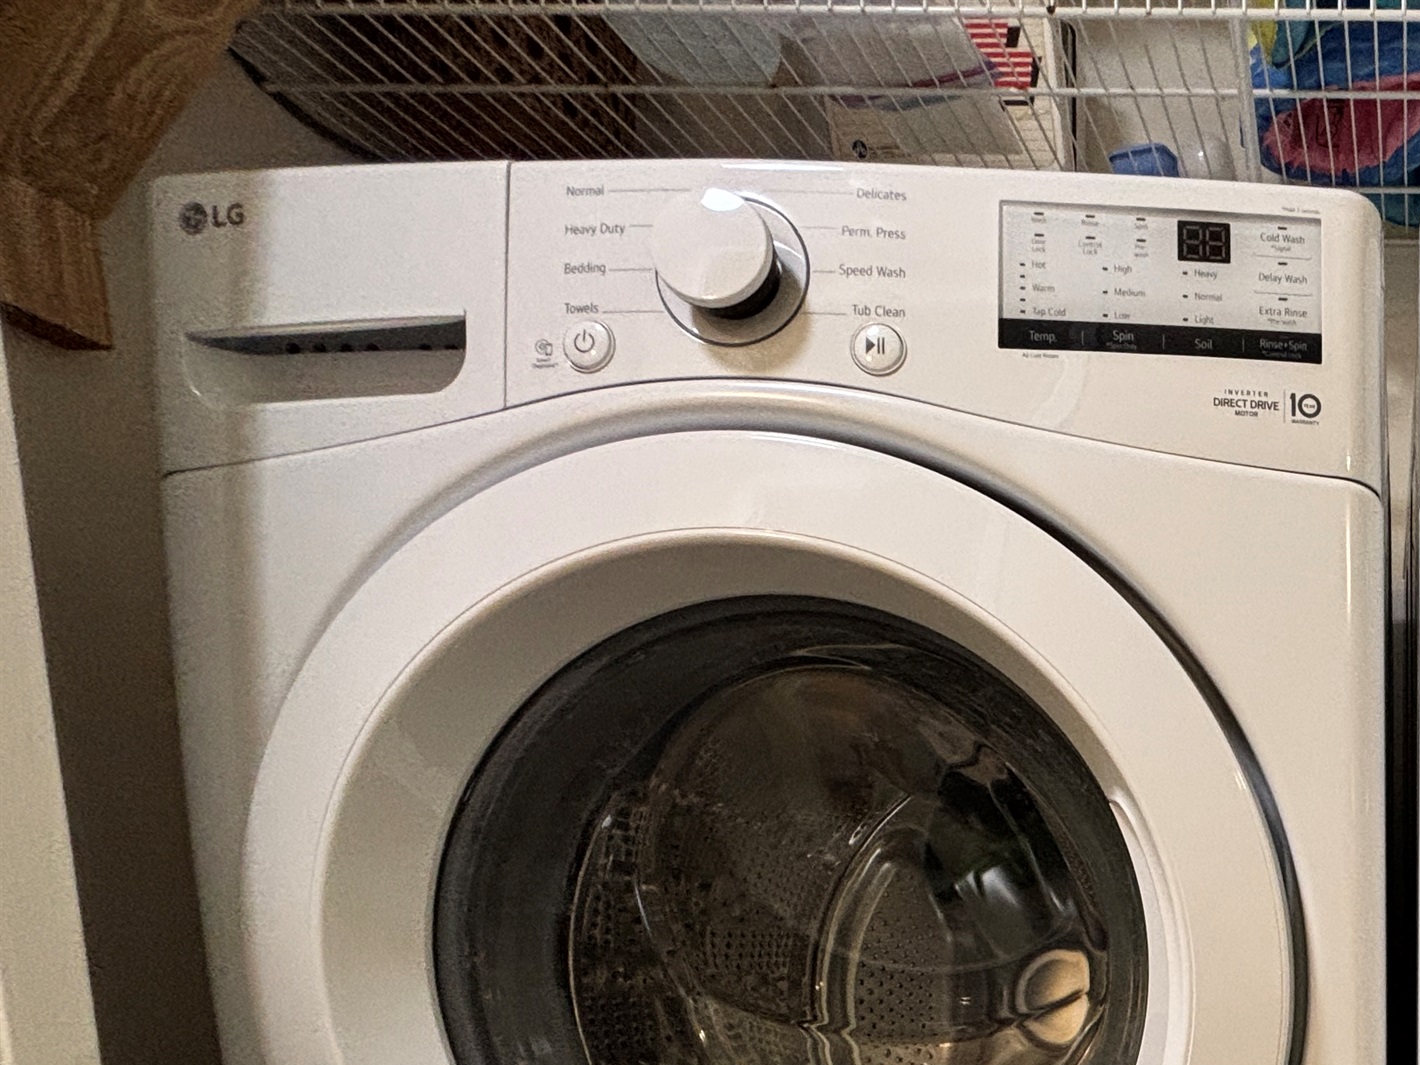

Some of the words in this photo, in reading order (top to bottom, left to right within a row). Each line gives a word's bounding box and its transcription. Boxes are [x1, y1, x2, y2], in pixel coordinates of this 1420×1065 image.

[566, 185, 604, 197] Normal
[857, 188, 907, 201] Delicates
[211, 203, 245, 227] LG
[564, 224, 596, 237] Heavy
[600, 222, 626, 237] Duty
[841, 225, 873, 238] Perm.
[876, 227, 906, 240] Press
[1260, 232, 1280, 243] Cold
[1282, 234, 1306, 245] Wash
[564, 262, 606, 276] Bedding
[1031, 260, 1046, 269] Hot
[1114, 264, 1133, 275] High
[839, 264, 873, 279] Speed
[876, 266, 906, 279] Wash
[1194, 269, 1218, 280] Heavy
[1258, 272, 1282, 285] Delay
[1285, 273, 1308, 285] Wash
[1032, 283, 1055, 292] Warm
[1114, 288, 1146, 297] Medium
[1194, 292, 1223, 302] Normal
[564, 302, 599, 314] Towels
[852, 304, 871, 317] Tub
[874, 305, 906, 318] Clean
[1033, 307, 1046, 317] Tap
[1048, 307, 1067, 317] Cold
[1259, 306, 1282, 317] Extra
[1284, 307, 1308, 318] Rinse
[1114, 311, 1131, 320] Low
[1194, 315, 1215, 325] Light
[1029, 330, 1058, 345] Temp.
[1112, 329, 1135, 343] Spin
[1194, 338, 1213, 350] Soil
[1260, 338, 1308, 352] Rinse+Spin
[1224, 389, 1269, 398] INVERTER
[1213, 397, 1248, 409] DIRECT
[1250, 400, 1280, 411] DRIVE
[1289, 392, 1322, 419] 10
[1234, 410, 1259, 418] MOTOR
